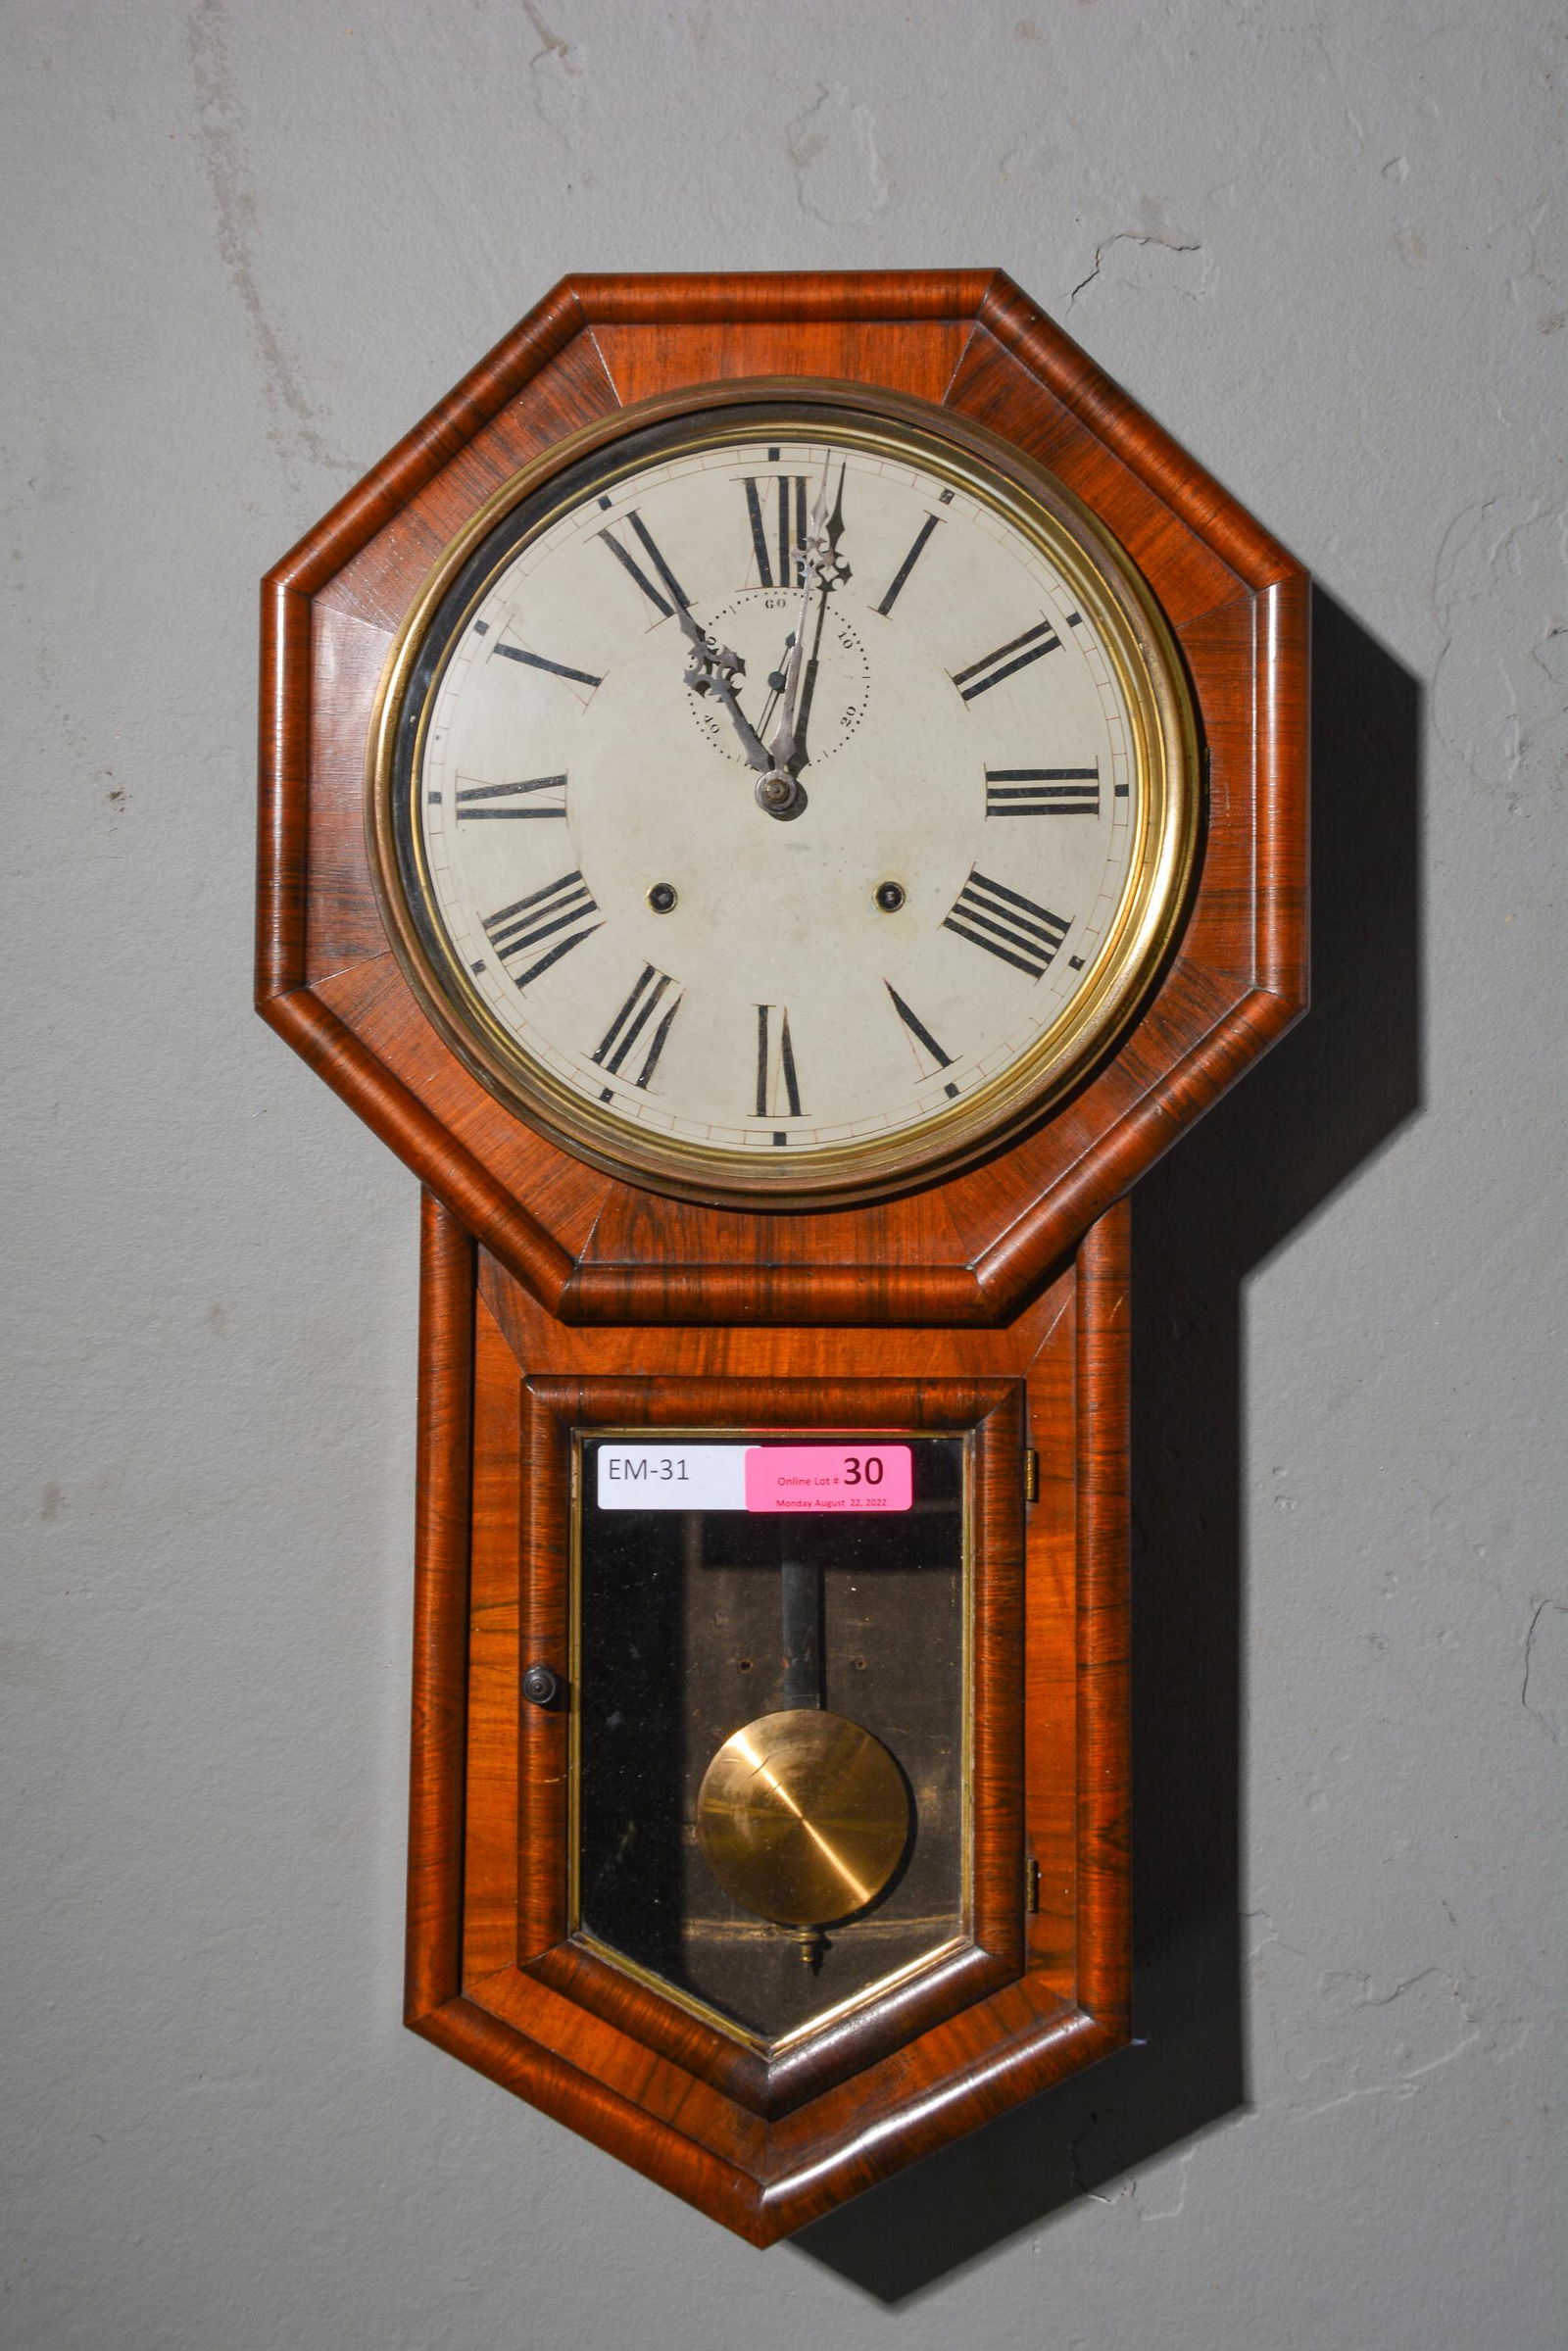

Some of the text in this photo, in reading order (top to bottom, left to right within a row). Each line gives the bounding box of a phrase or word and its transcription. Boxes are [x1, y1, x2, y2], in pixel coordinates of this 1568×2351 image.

[866, 510, 948, 620] I
[764, 598, 787, 610] 60
[837, 631, 854, 650] 10
[945, 609, 1064, 711] II
[703, 714, 720, 734] 40
[840, 706, 857, 727] 20
[986, 755, 1099, 820] III
[476, 861, 608, 999] VIII
[939, 861, 1074, 982] IIII
[580, 959, 686, 1095] VII
[747, 1004, 809, 1118] VI
[609, 1458, 690, 1481] EM-31
[777, 1457, 884, 1487] Online Lot # 30
[776, 1498, 887, 1508] Monday August 22, 2022
